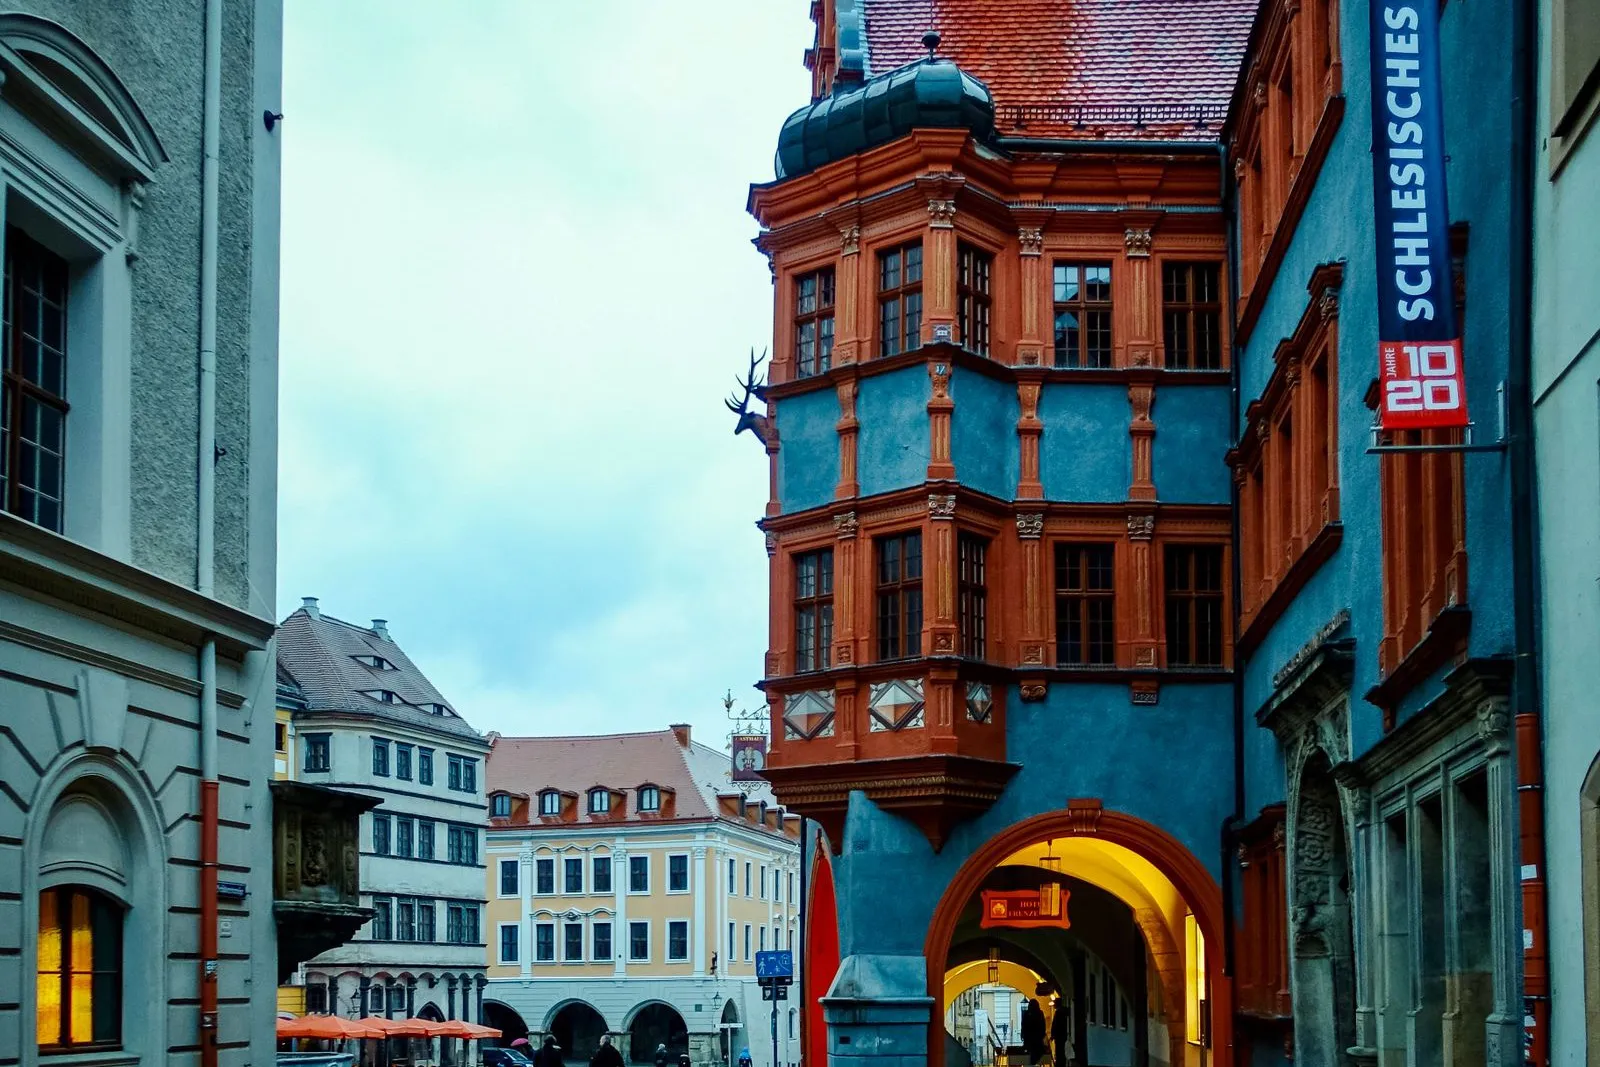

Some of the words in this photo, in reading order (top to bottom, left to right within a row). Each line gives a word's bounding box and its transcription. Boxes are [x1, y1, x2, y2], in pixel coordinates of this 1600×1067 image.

[1384, 6, 1434, 321] SCHLESISCHES
[1384, 347, 1397, 378] JAHRE
[1403, 345, 1456, 377] 10
[1386, 379, 1460, 412] 20
